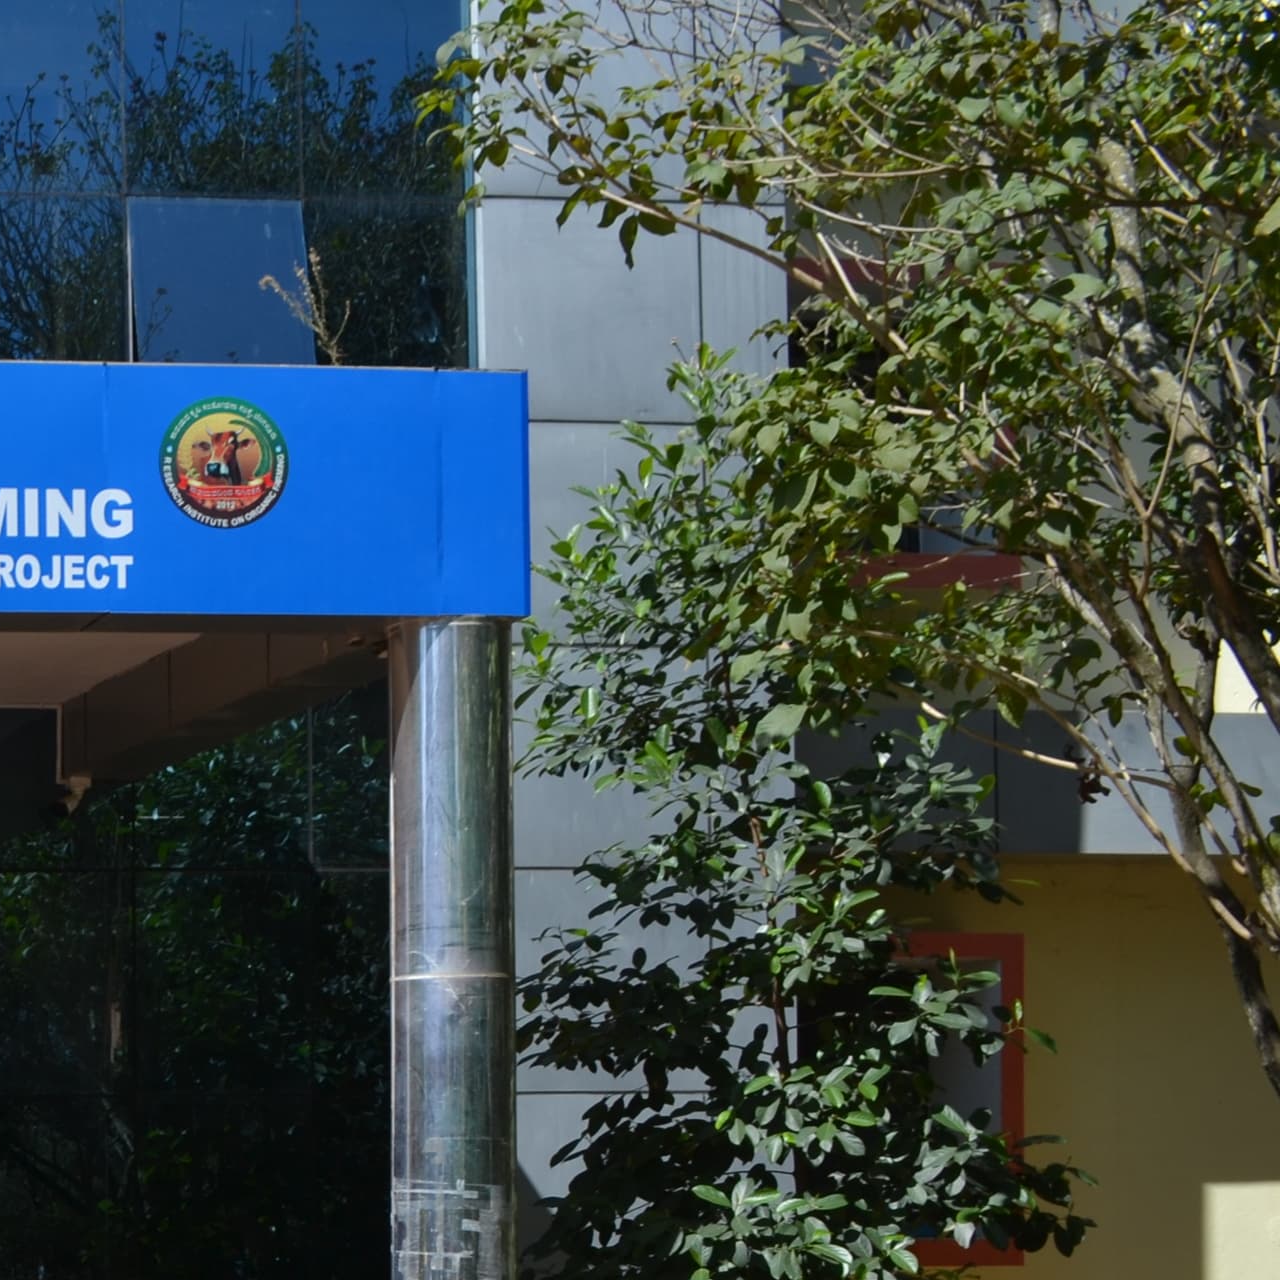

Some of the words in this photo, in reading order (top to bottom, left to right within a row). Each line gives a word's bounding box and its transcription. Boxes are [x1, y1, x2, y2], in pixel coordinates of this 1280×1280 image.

[163, 456, 184, 506] RESEARCH
[183, 503, 229, 527] INSTITUTE
[230, 515, 245, 526] ON
[244, 490, 277, 521] ORGANIC
